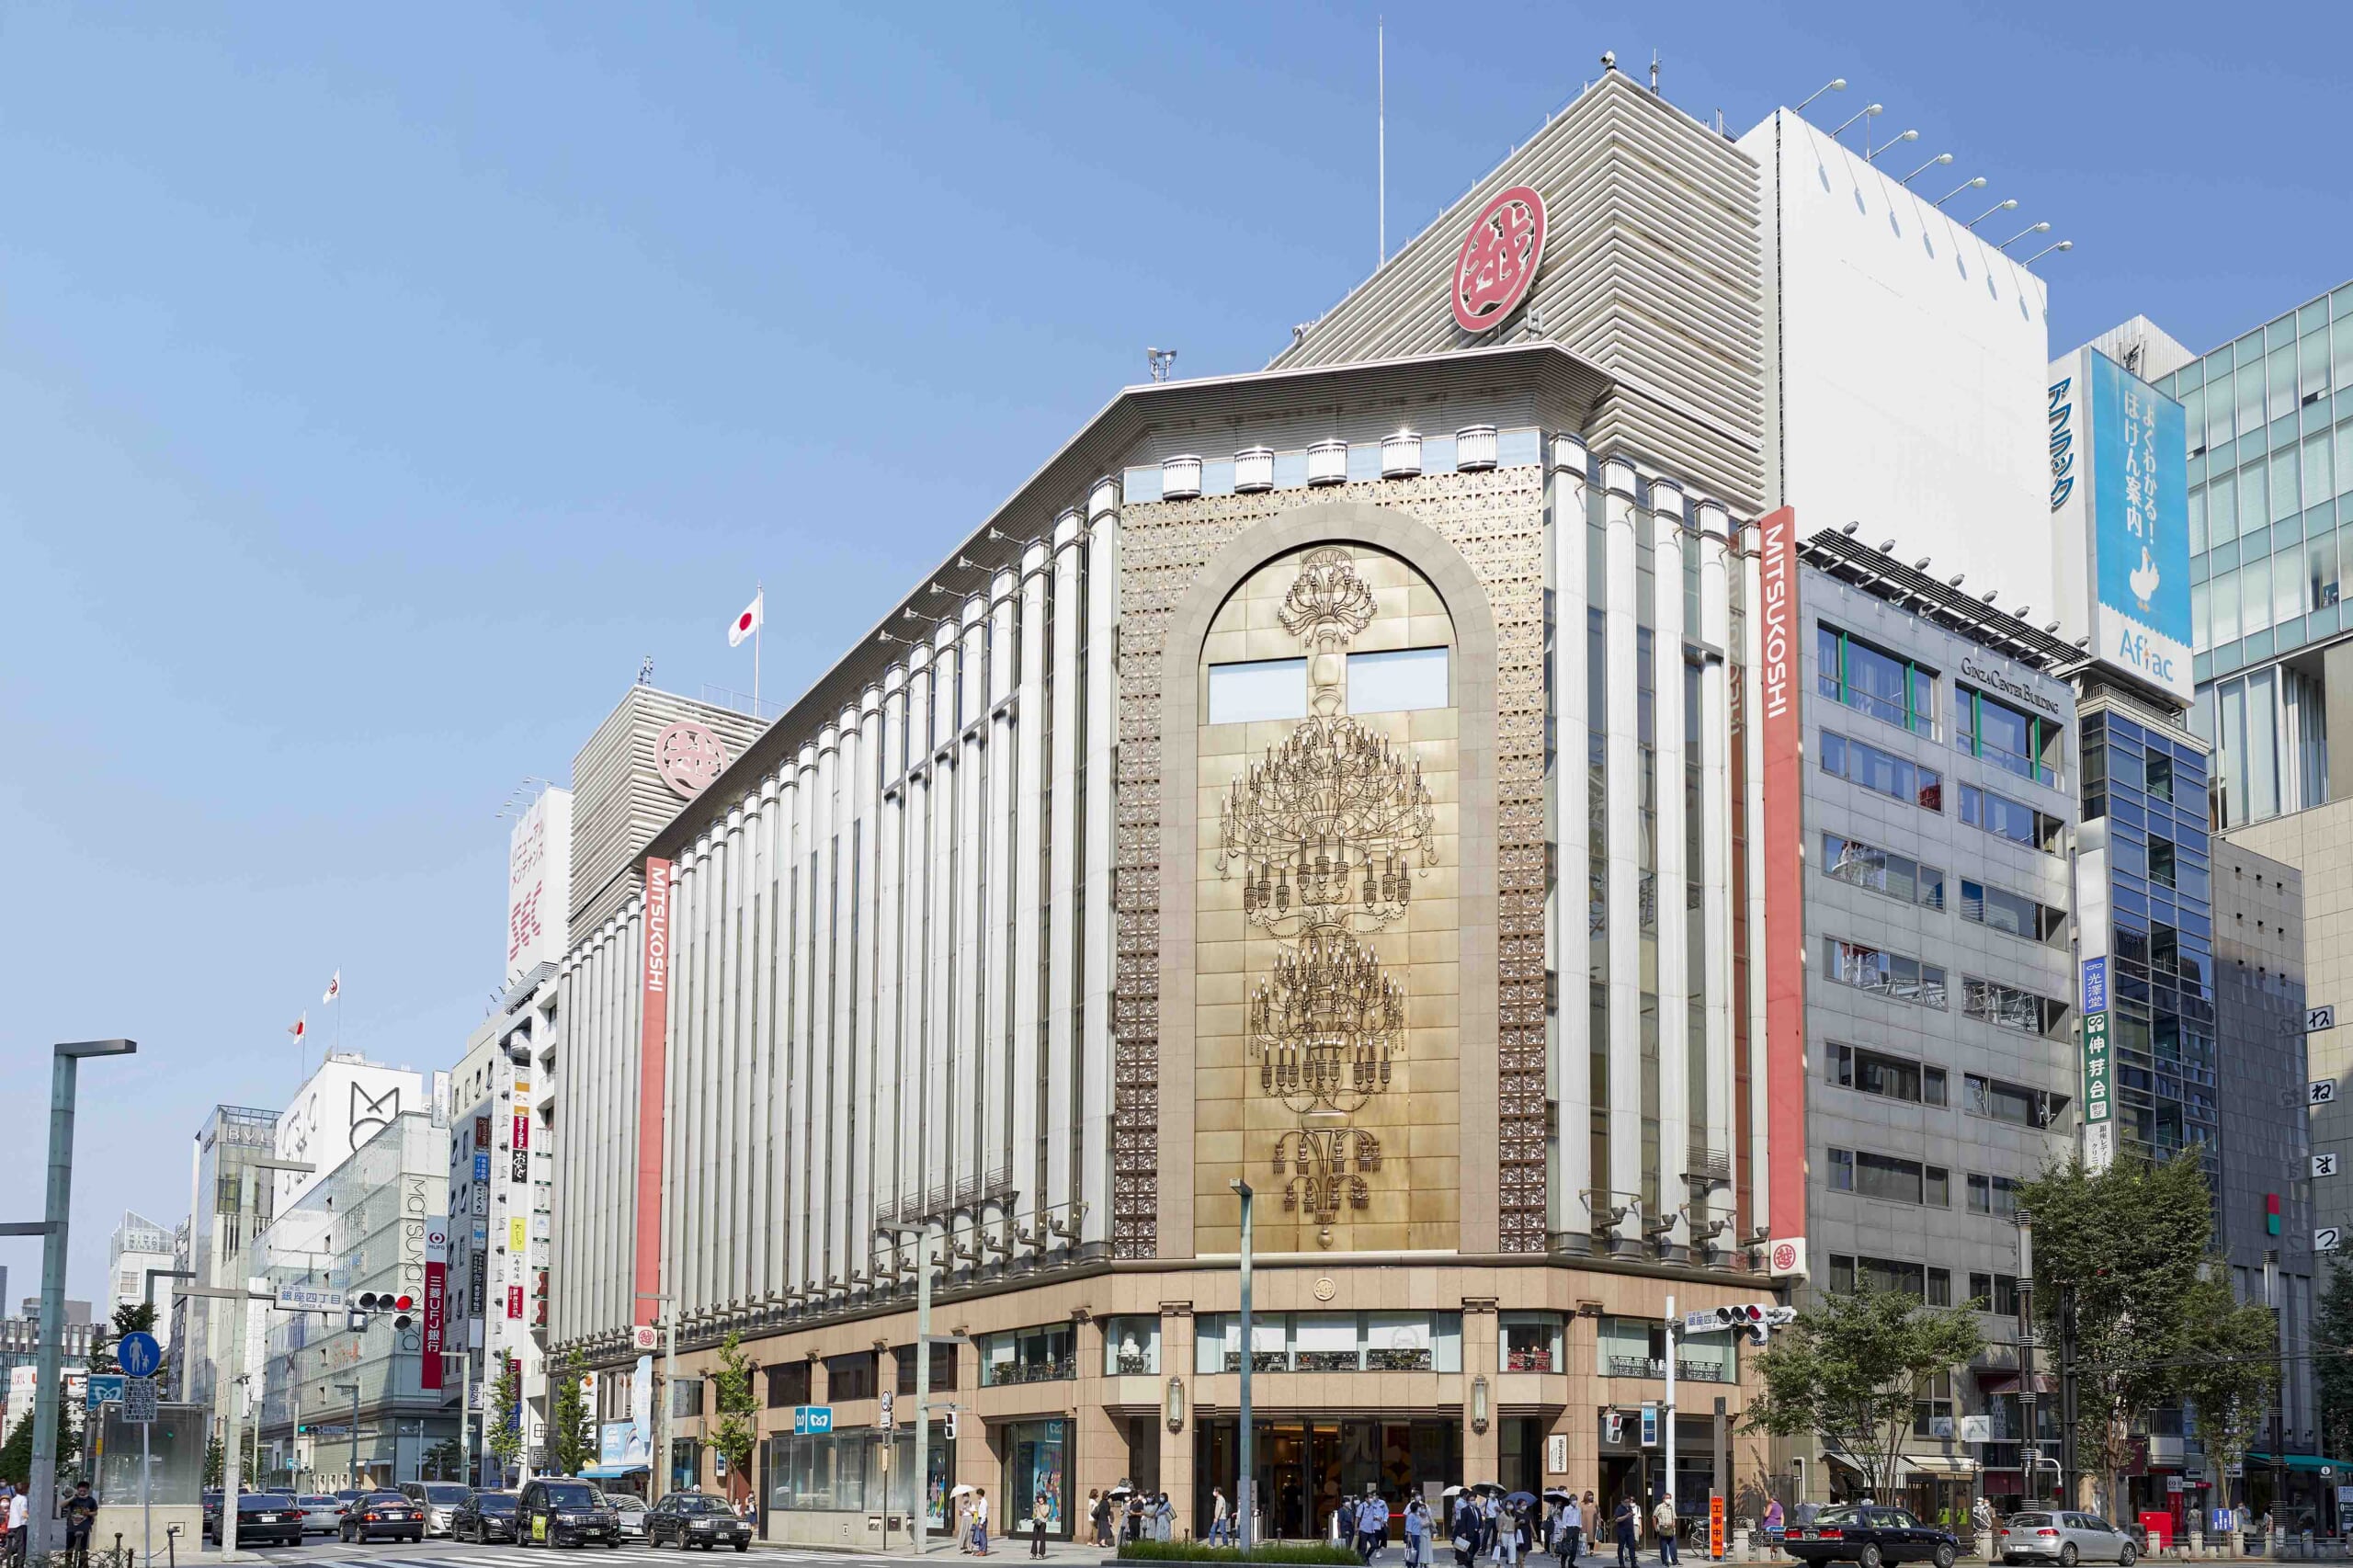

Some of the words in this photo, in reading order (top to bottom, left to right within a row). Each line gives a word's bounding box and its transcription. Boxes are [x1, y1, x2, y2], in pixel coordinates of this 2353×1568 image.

[2048, 377, 2075, 507] アフラック
[2124, 390, 2143, 539] ほけん案内
[2143, 403, 2157, 545] よくわかる！
[1765, 522, 1787, 720] MITSUKOSHI
[2119, 628, 2174, 682] Aflac
[648, 866, 666, 992] MITSUKOSHI
[2086, 972, 2103, 1009] 光澤堂
[2088, 1036, 2106, 1100] 伸芽会
[2312, 1083, 2331, 1101] ね
[228, 1129, 277, 1142] BVL
[2317, 1229, 2336, 1247] つ
[281, 1290, 341, 1305] 銀座四丁目
[426, 1275, 441, 1353] 三菱UFJ銀行
[1688, 1314, 1718, 1325] 銀座四丁
